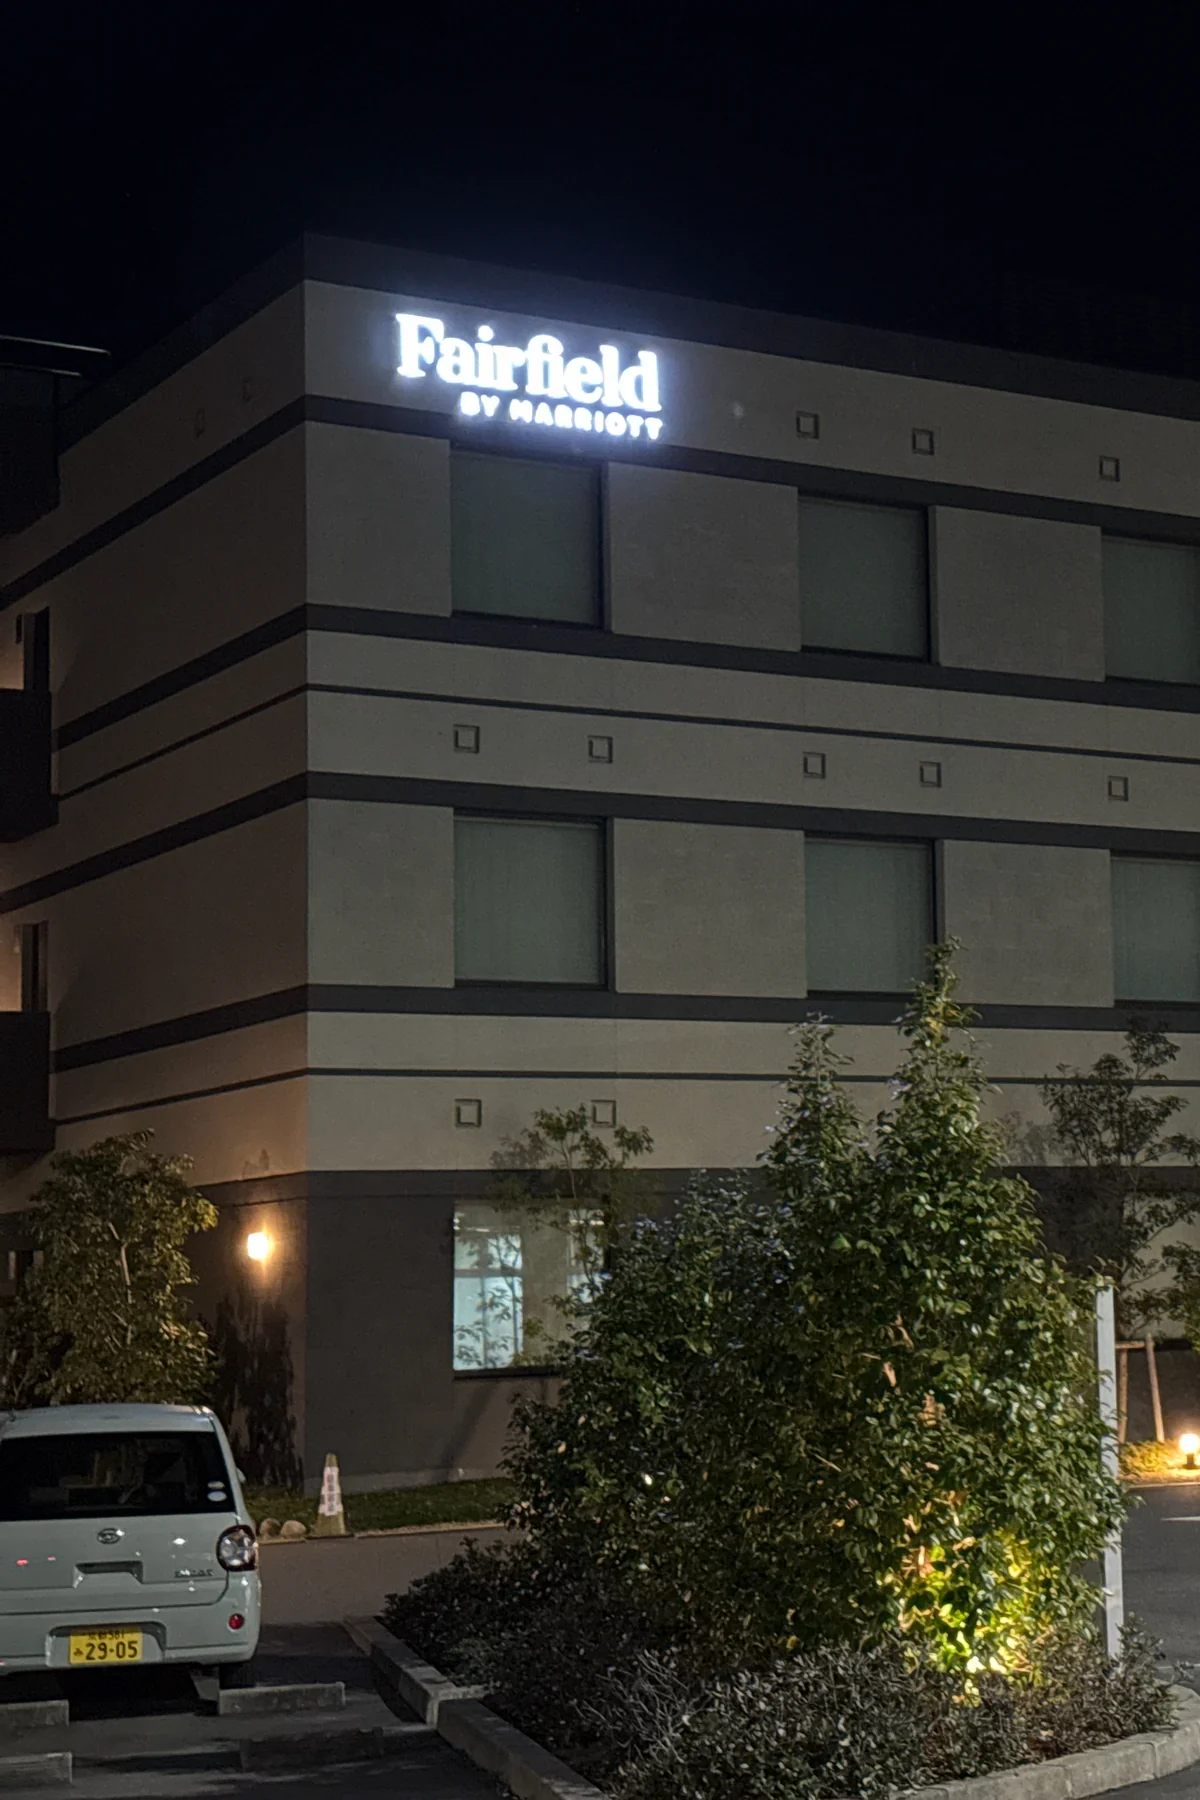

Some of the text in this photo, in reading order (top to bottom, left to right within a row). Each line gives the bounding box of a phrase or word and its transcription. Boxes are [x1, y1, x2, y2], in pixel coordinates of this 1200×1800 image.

[395, 313, 662, 412] Fairfield
[459, 391, 664, 440] BY MARRIOTT
